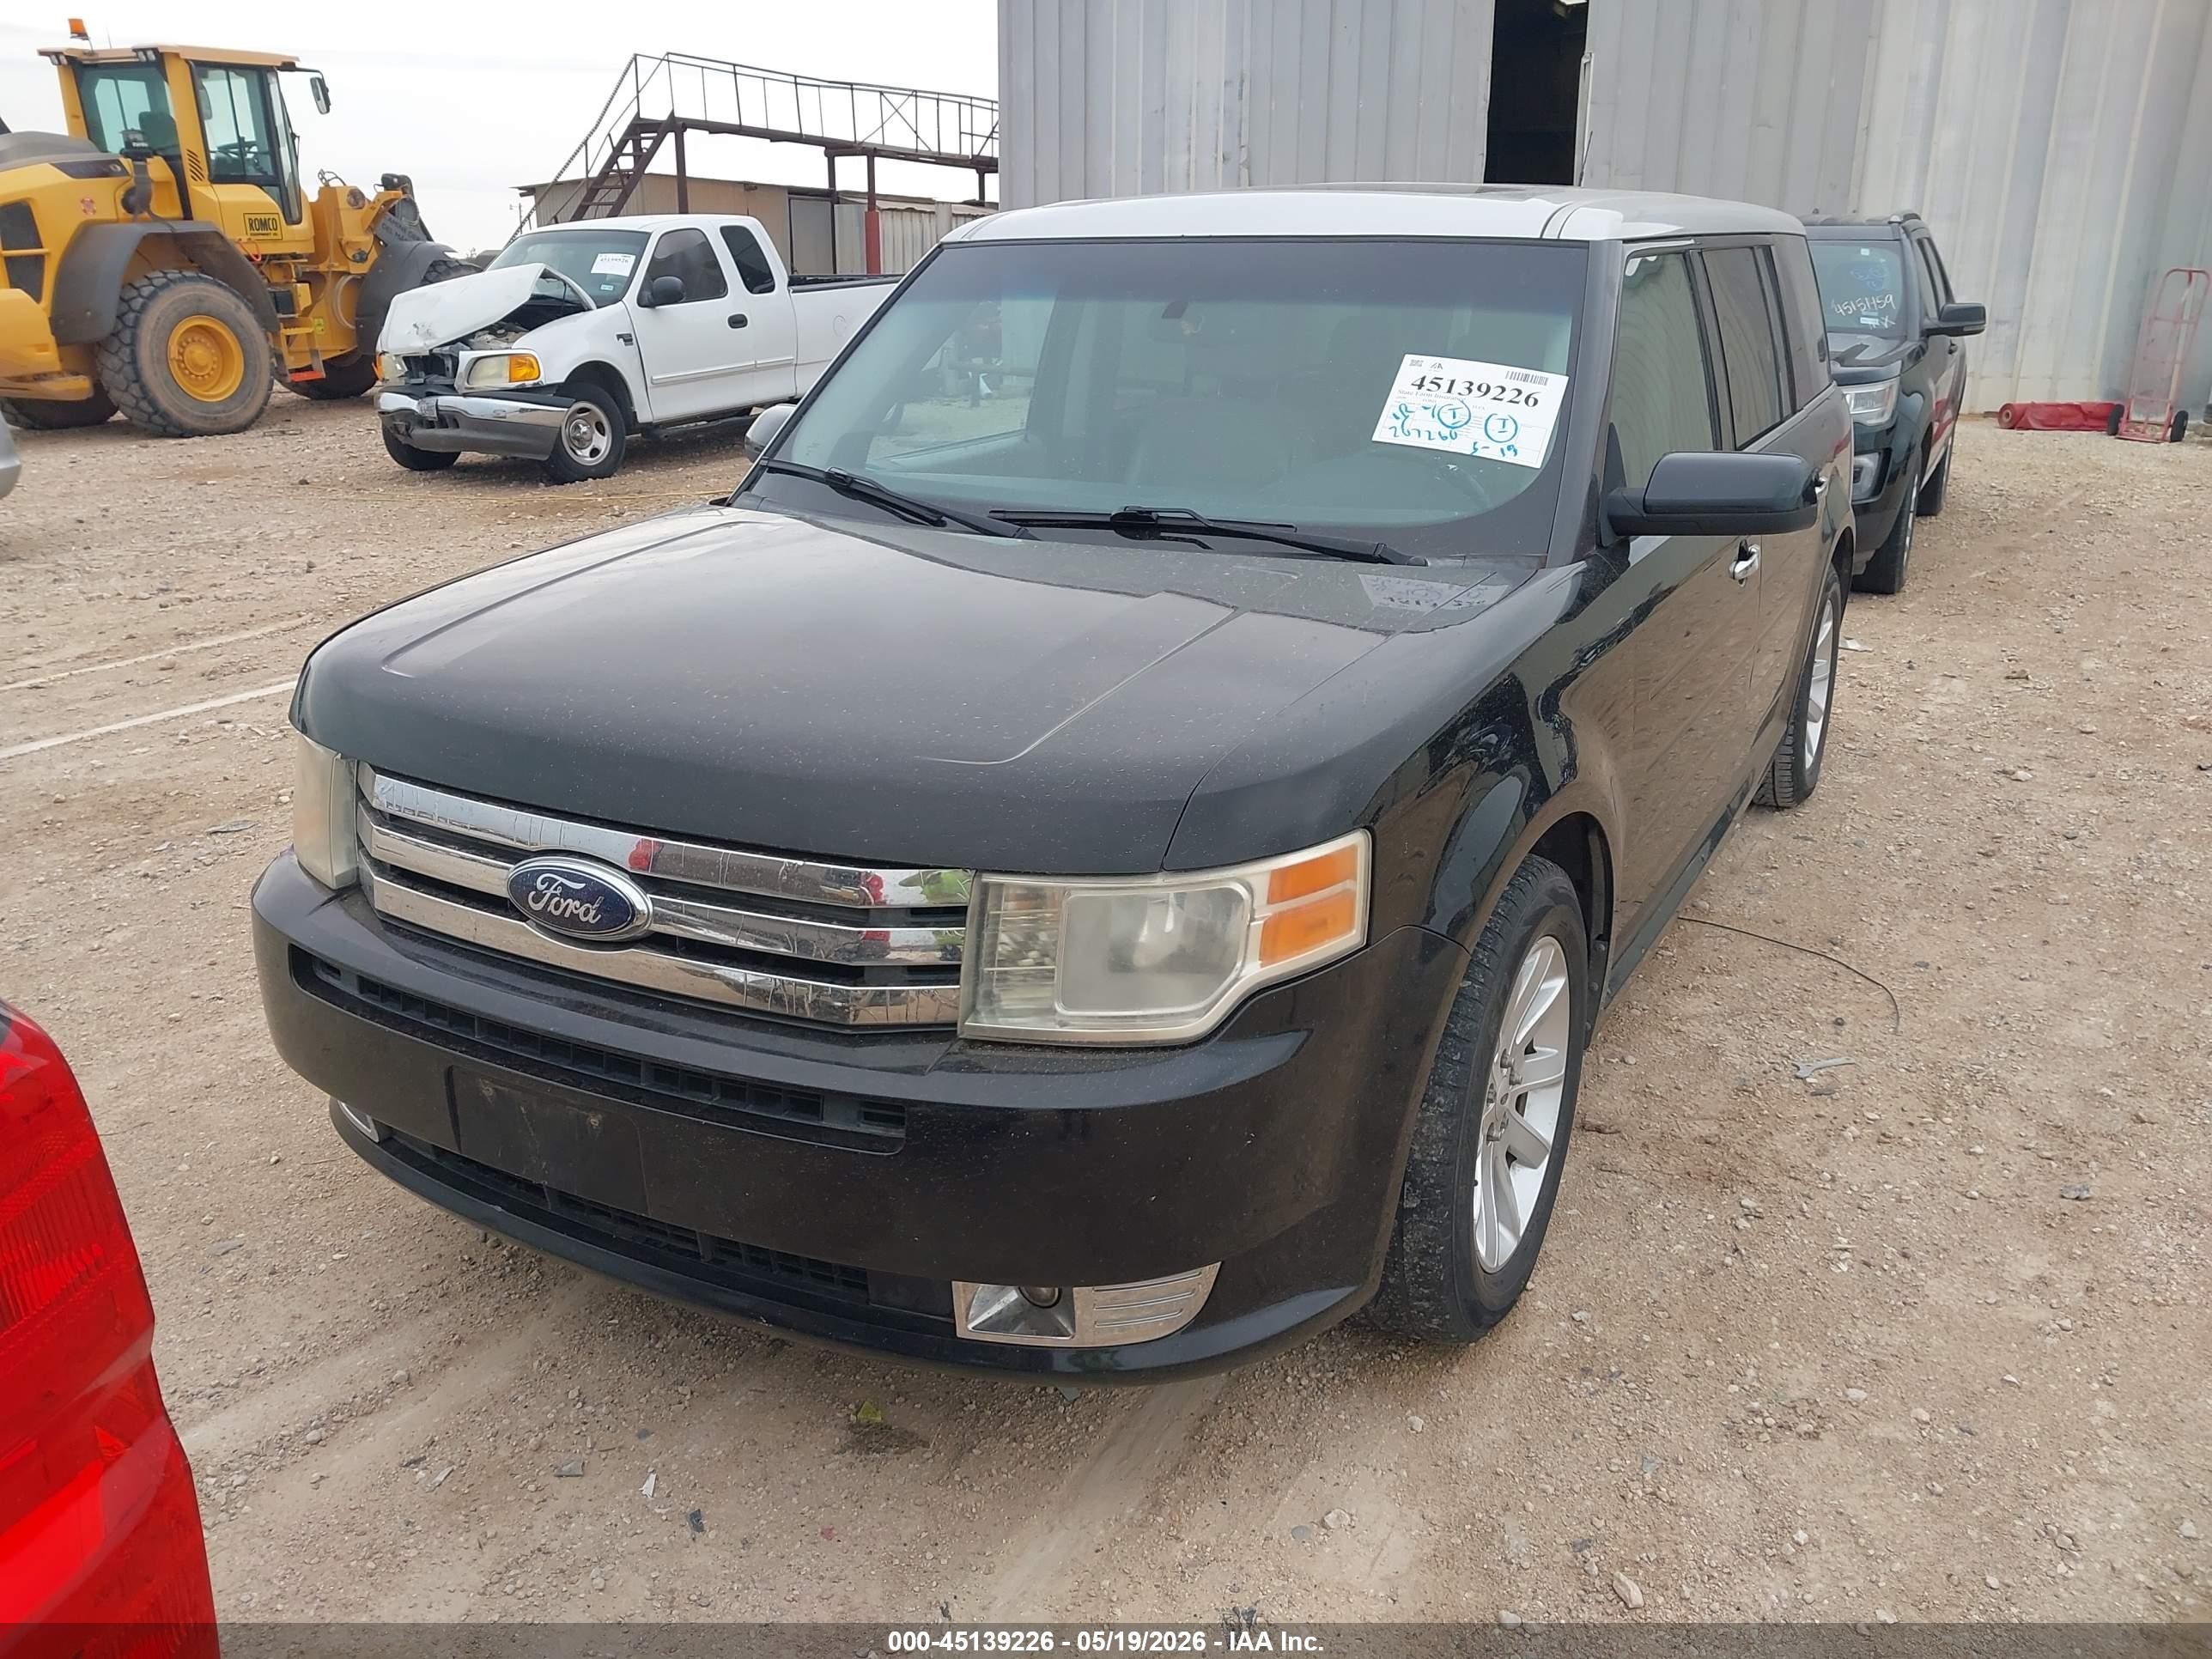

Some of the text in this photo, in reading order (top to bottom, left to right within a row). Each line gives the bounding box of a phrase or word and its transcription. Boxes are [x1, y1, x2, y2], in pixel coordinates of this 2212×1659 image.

[248, 217, 278, 231] ROMCO
[1834, 295, 1896, 316] 45151459
[1411, 374, 1542, 408] 45139226
[527, 872, 605, 925] Ford
